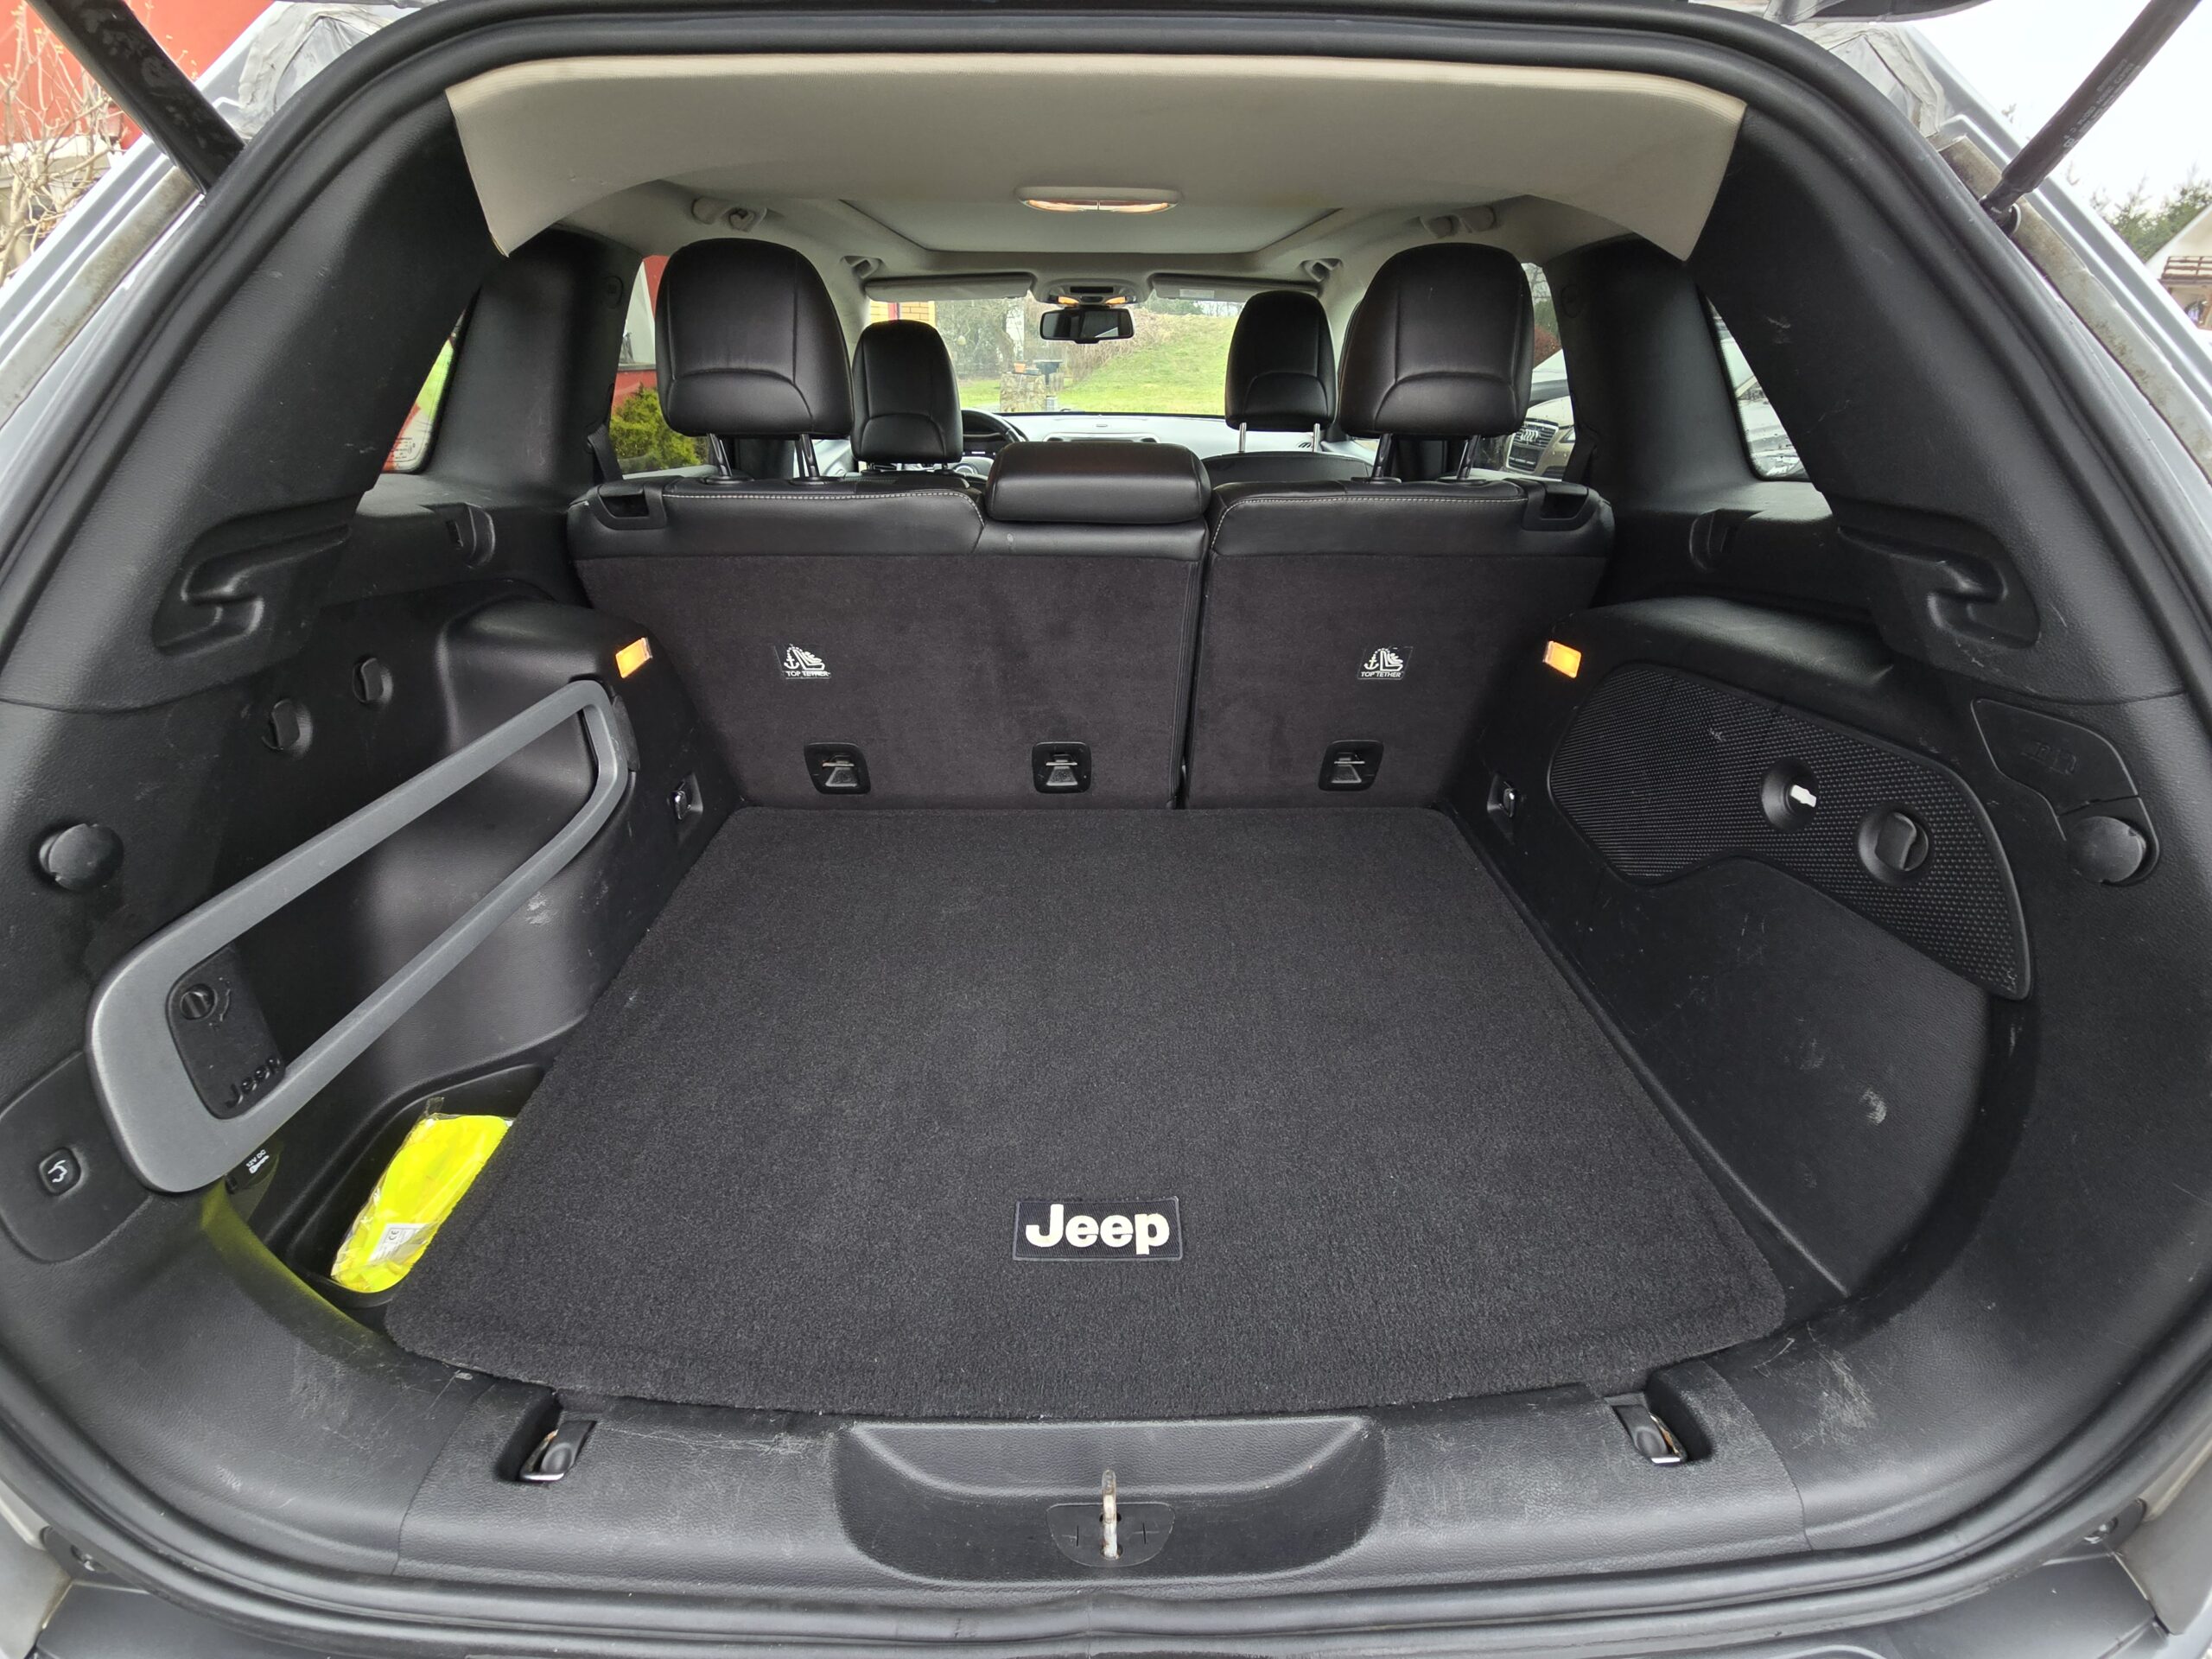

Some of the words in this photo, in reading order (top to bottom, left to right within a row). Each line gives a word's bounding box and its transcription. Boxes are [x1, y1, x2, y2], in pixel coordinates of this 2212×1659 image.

[226, 1056, 281, 1108] Jeep
[256, 1149, 266, 1159] DC
[1026, 1204, 1170, 1255] Jeep
